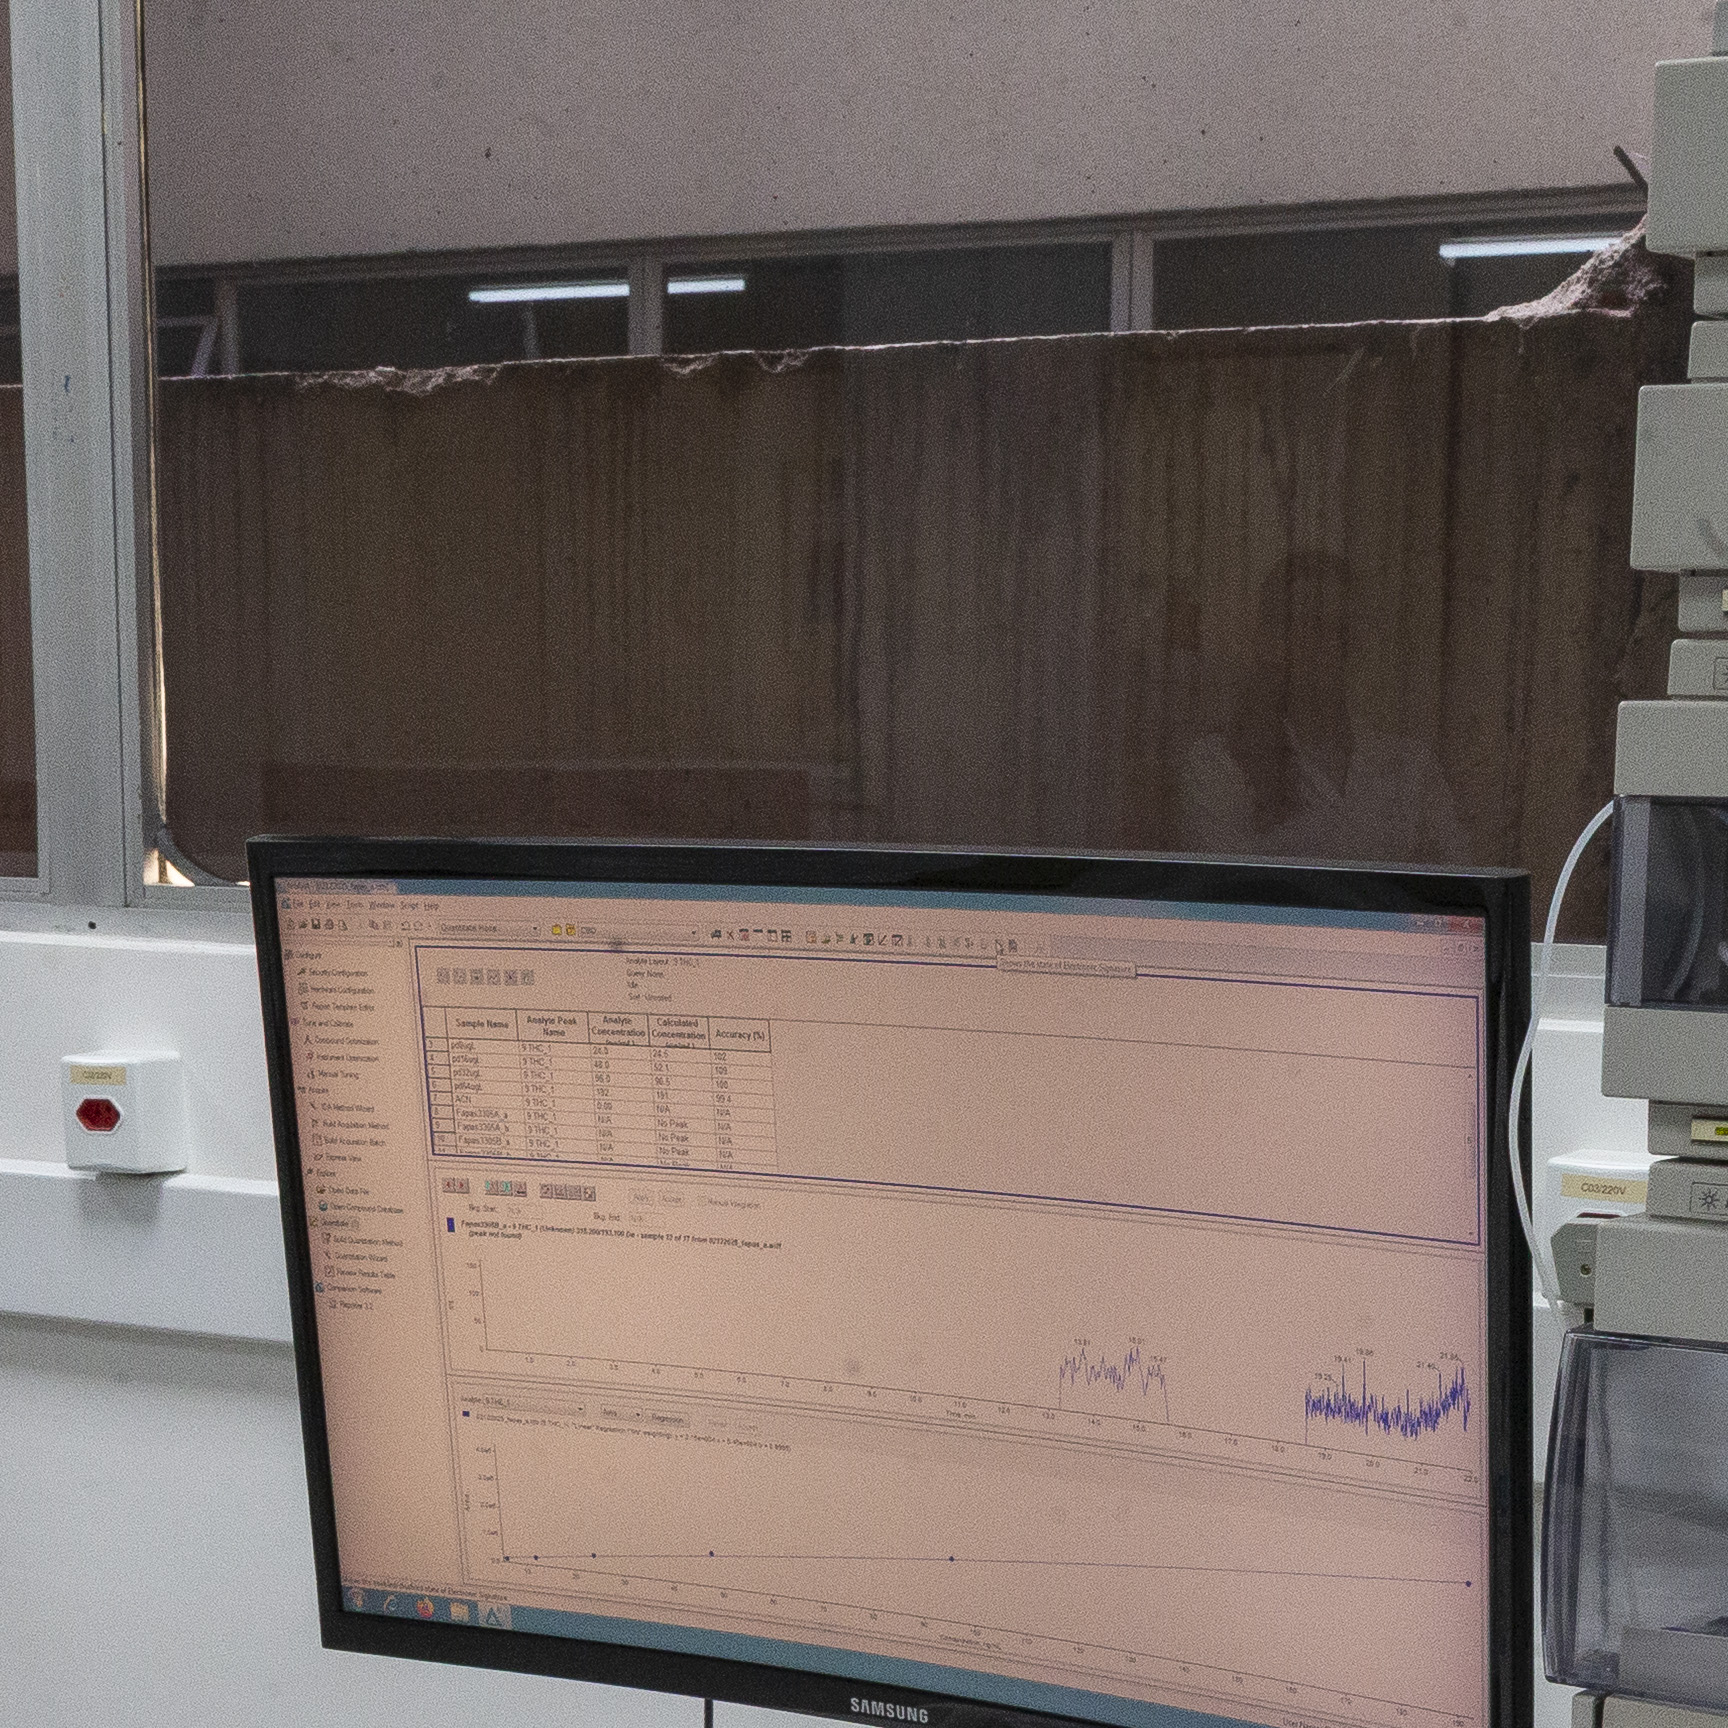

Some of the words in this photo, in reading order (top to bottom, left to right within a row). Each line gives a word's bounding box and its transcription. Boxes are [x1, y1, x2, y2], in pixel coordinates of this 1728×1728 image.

[591, 1026, 646, 1038] Concentration
[651, 1029, 706, 1041] Concentration
[850, 1697, 928, 1723] SAMSUNG
